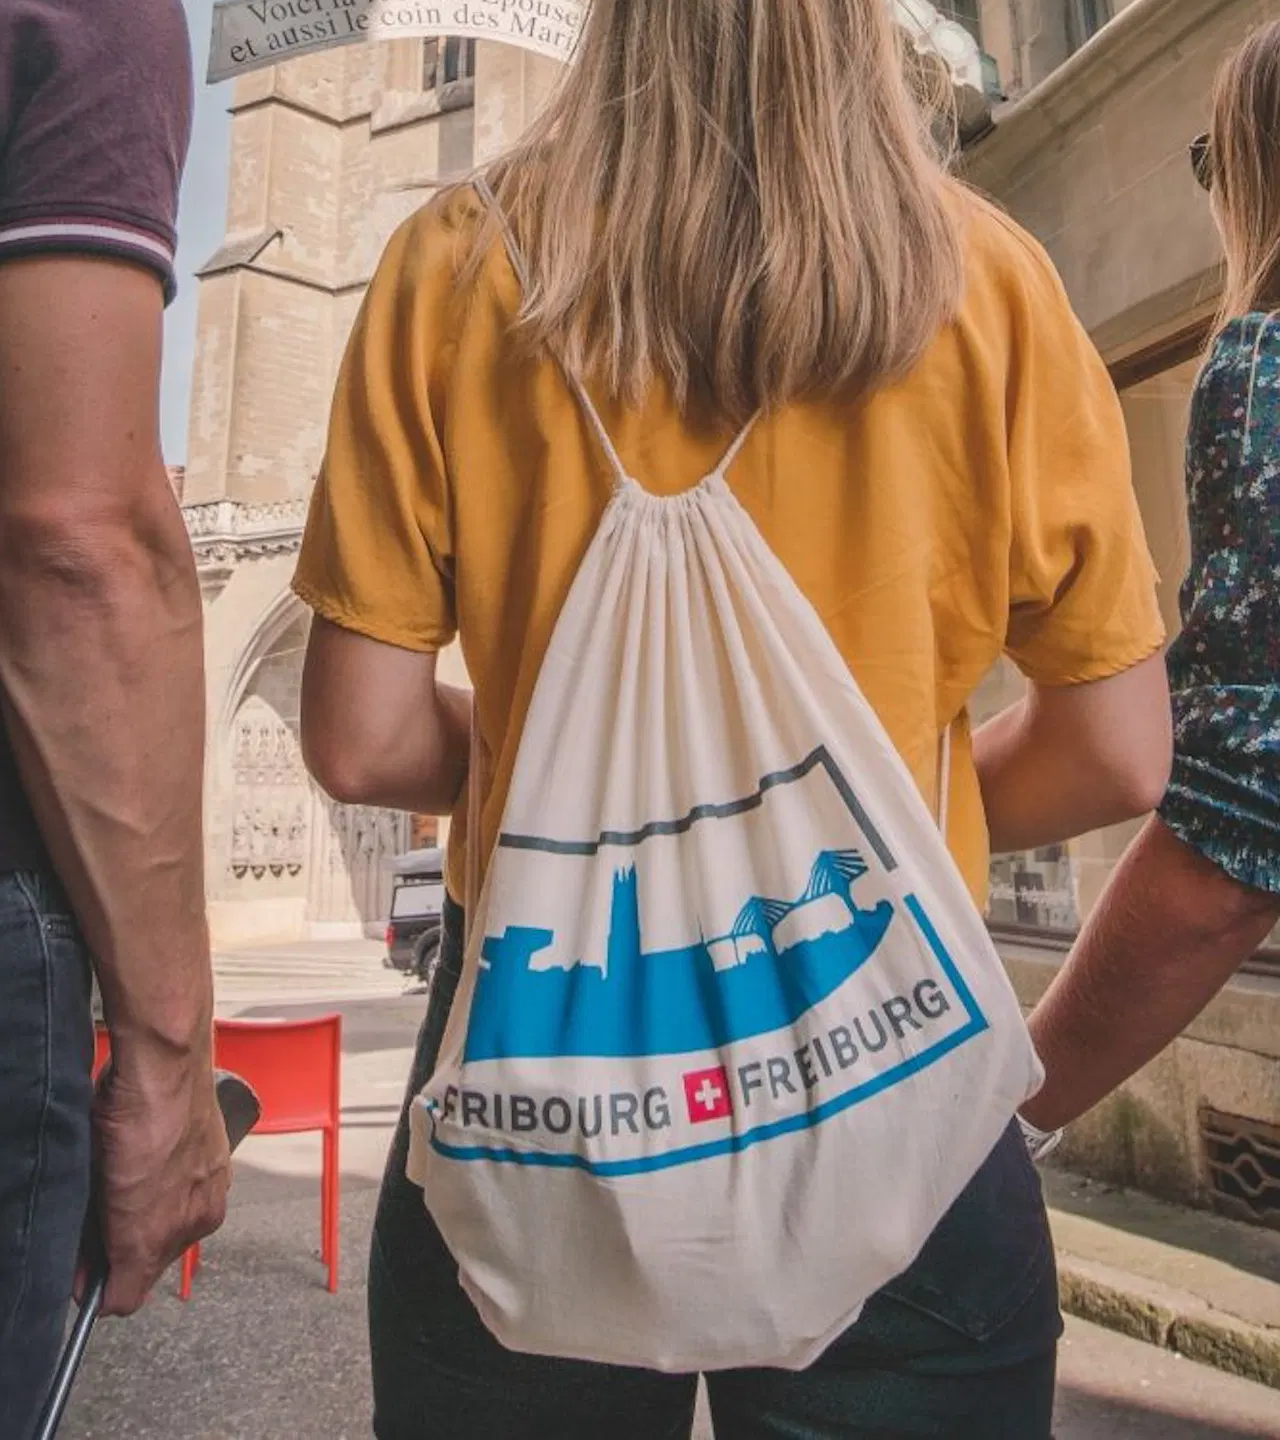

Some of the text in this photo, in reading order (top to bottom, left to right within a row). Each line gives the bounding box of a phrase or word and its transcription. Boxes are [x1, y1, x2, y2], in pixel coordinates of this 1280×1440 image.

[229, 1, 574, 63] et aussi le coin des Mari
[441, 978, 952, 1139] FRIBOURG FREIBURG
